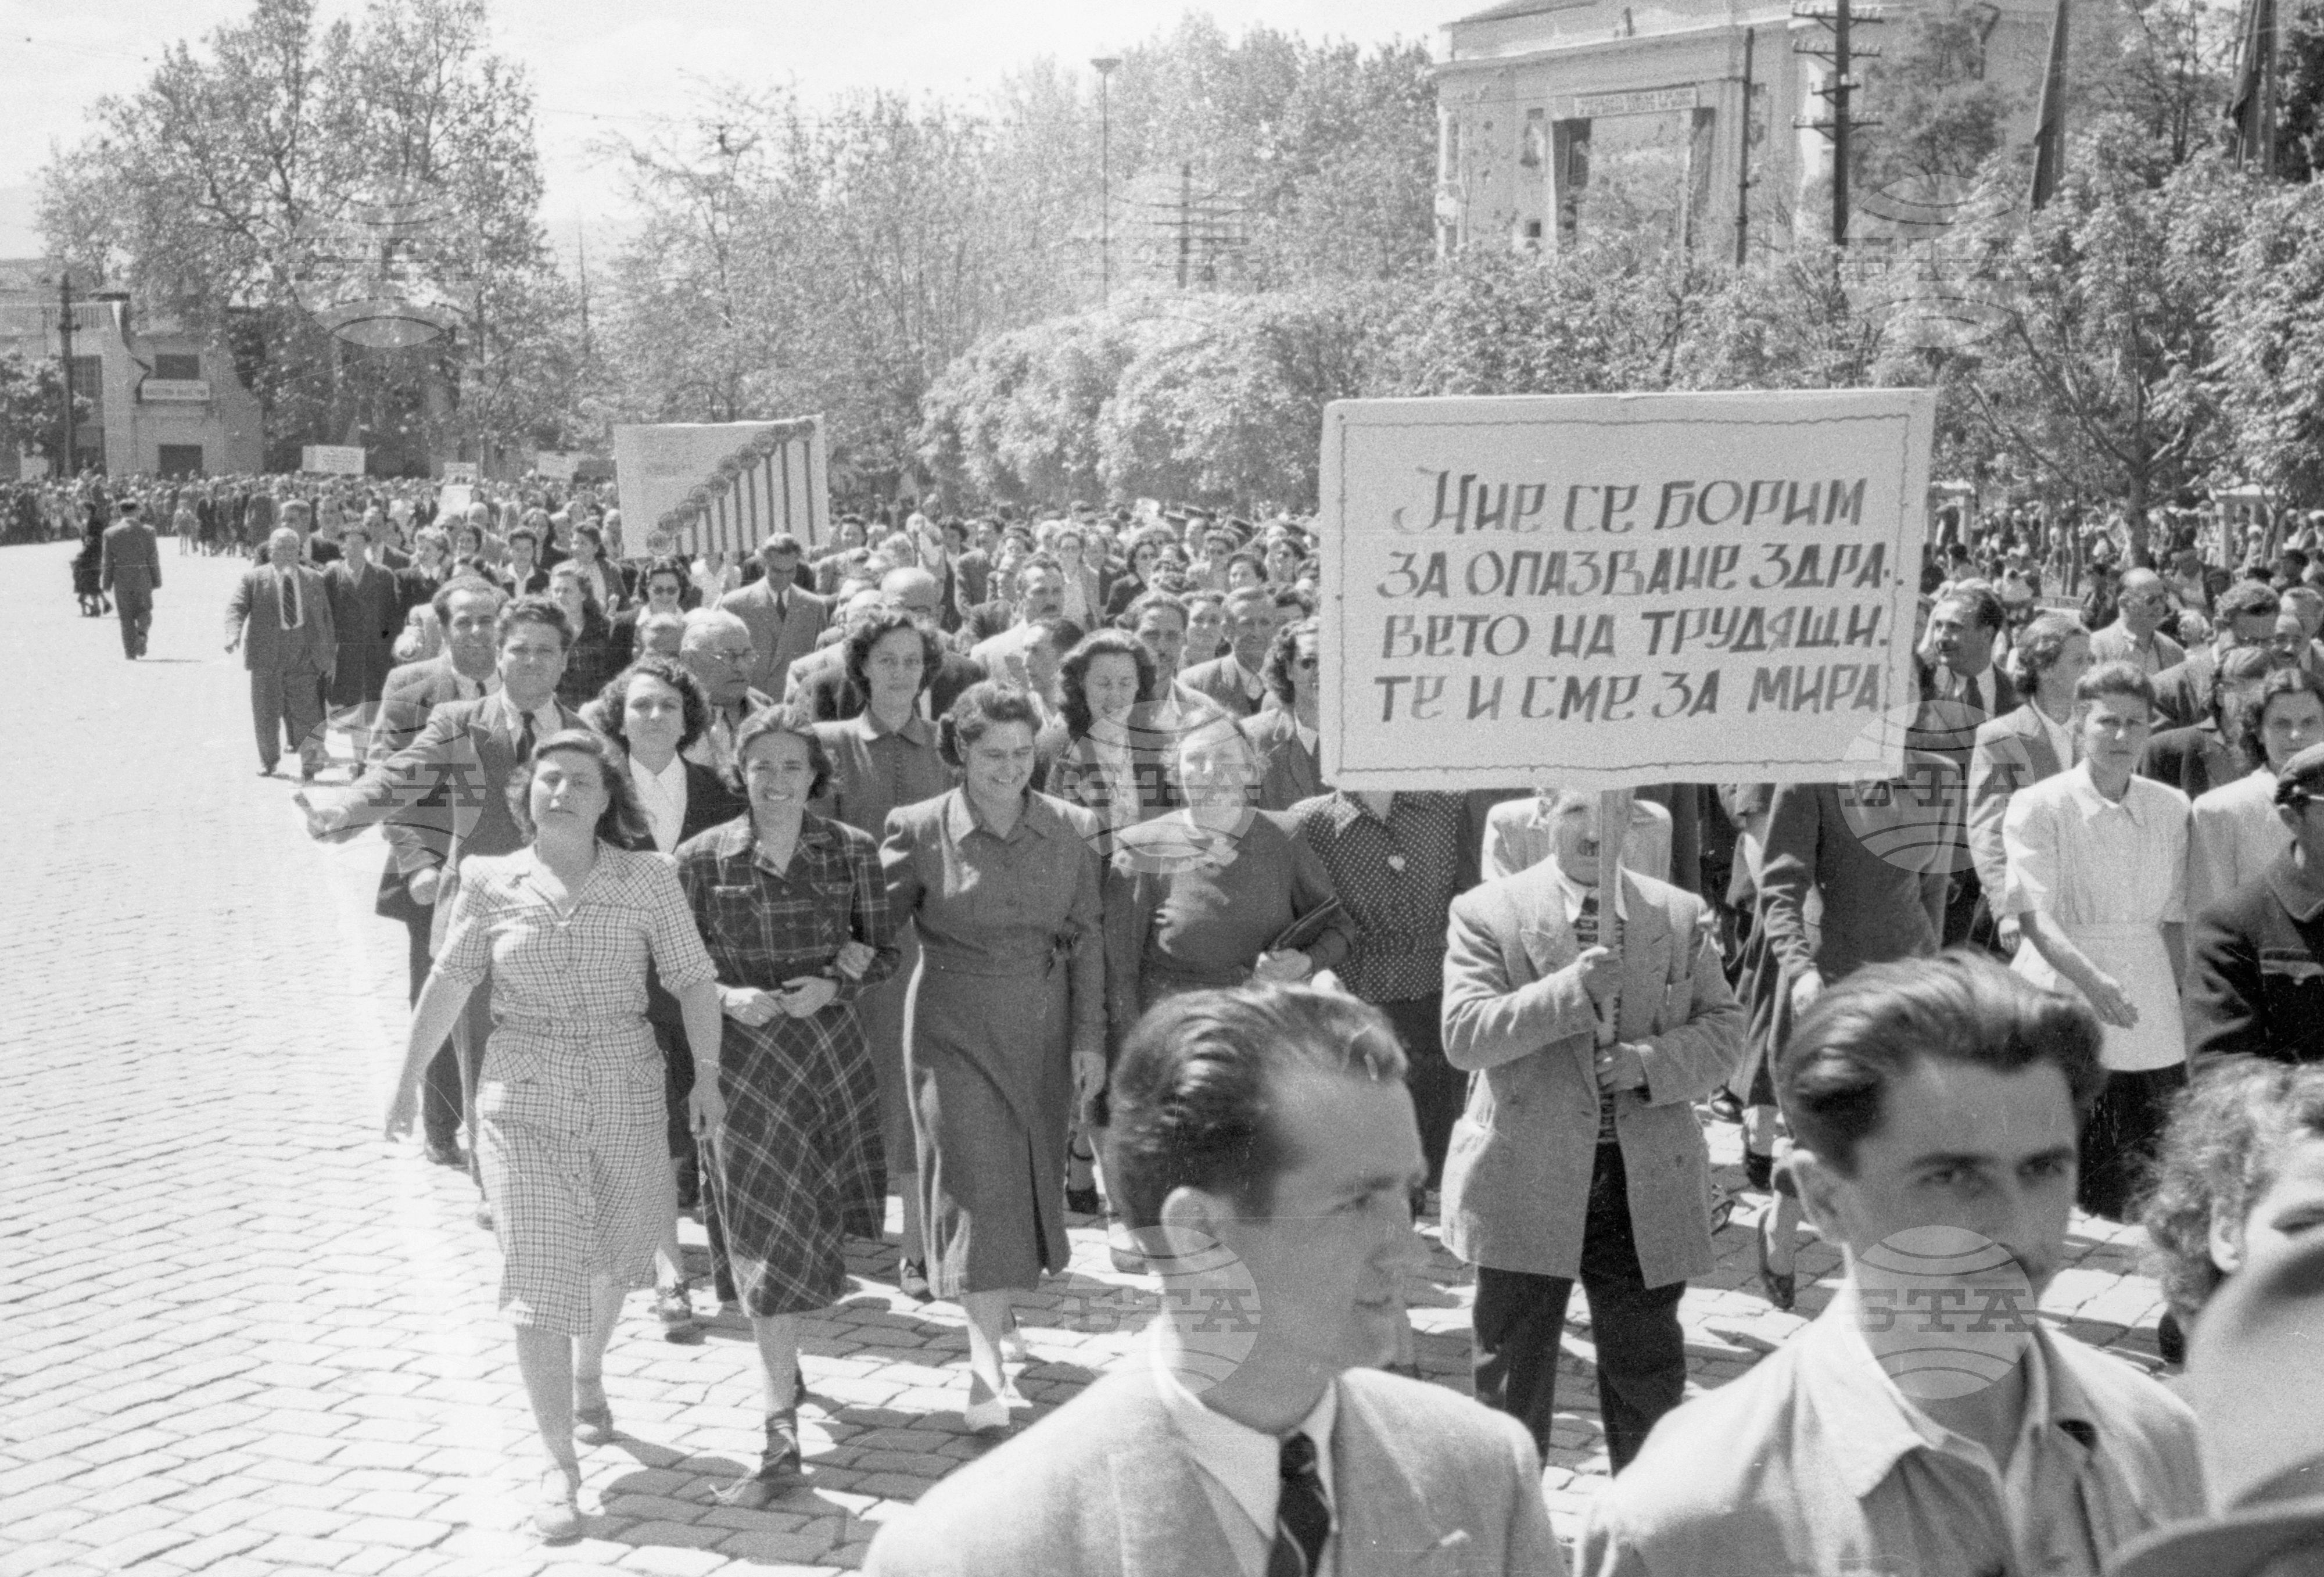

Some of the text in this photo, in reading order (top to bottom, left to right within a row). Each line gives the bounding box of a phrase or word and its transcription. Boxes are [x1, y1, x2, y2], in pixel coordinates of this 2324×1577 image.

[1564, 483, 1640, 533] СЕ
[1654, 477, 1868, 530] БОРИМ
[1376, 550, 1448, 598] ЗА
[1465, 543, 1742, 597] ОПАЗВАНЕ
[1382, 614, 1530, 659] ВЕТО
[1548, 614, 1616, 660] НА
[1374, 675, 1448, 723] ТЕ
[1466, 675, 1505, 721] И
[1520, 674, 1643, 722] СМЕ
[1651, 669, 1720, 718] ЗА
